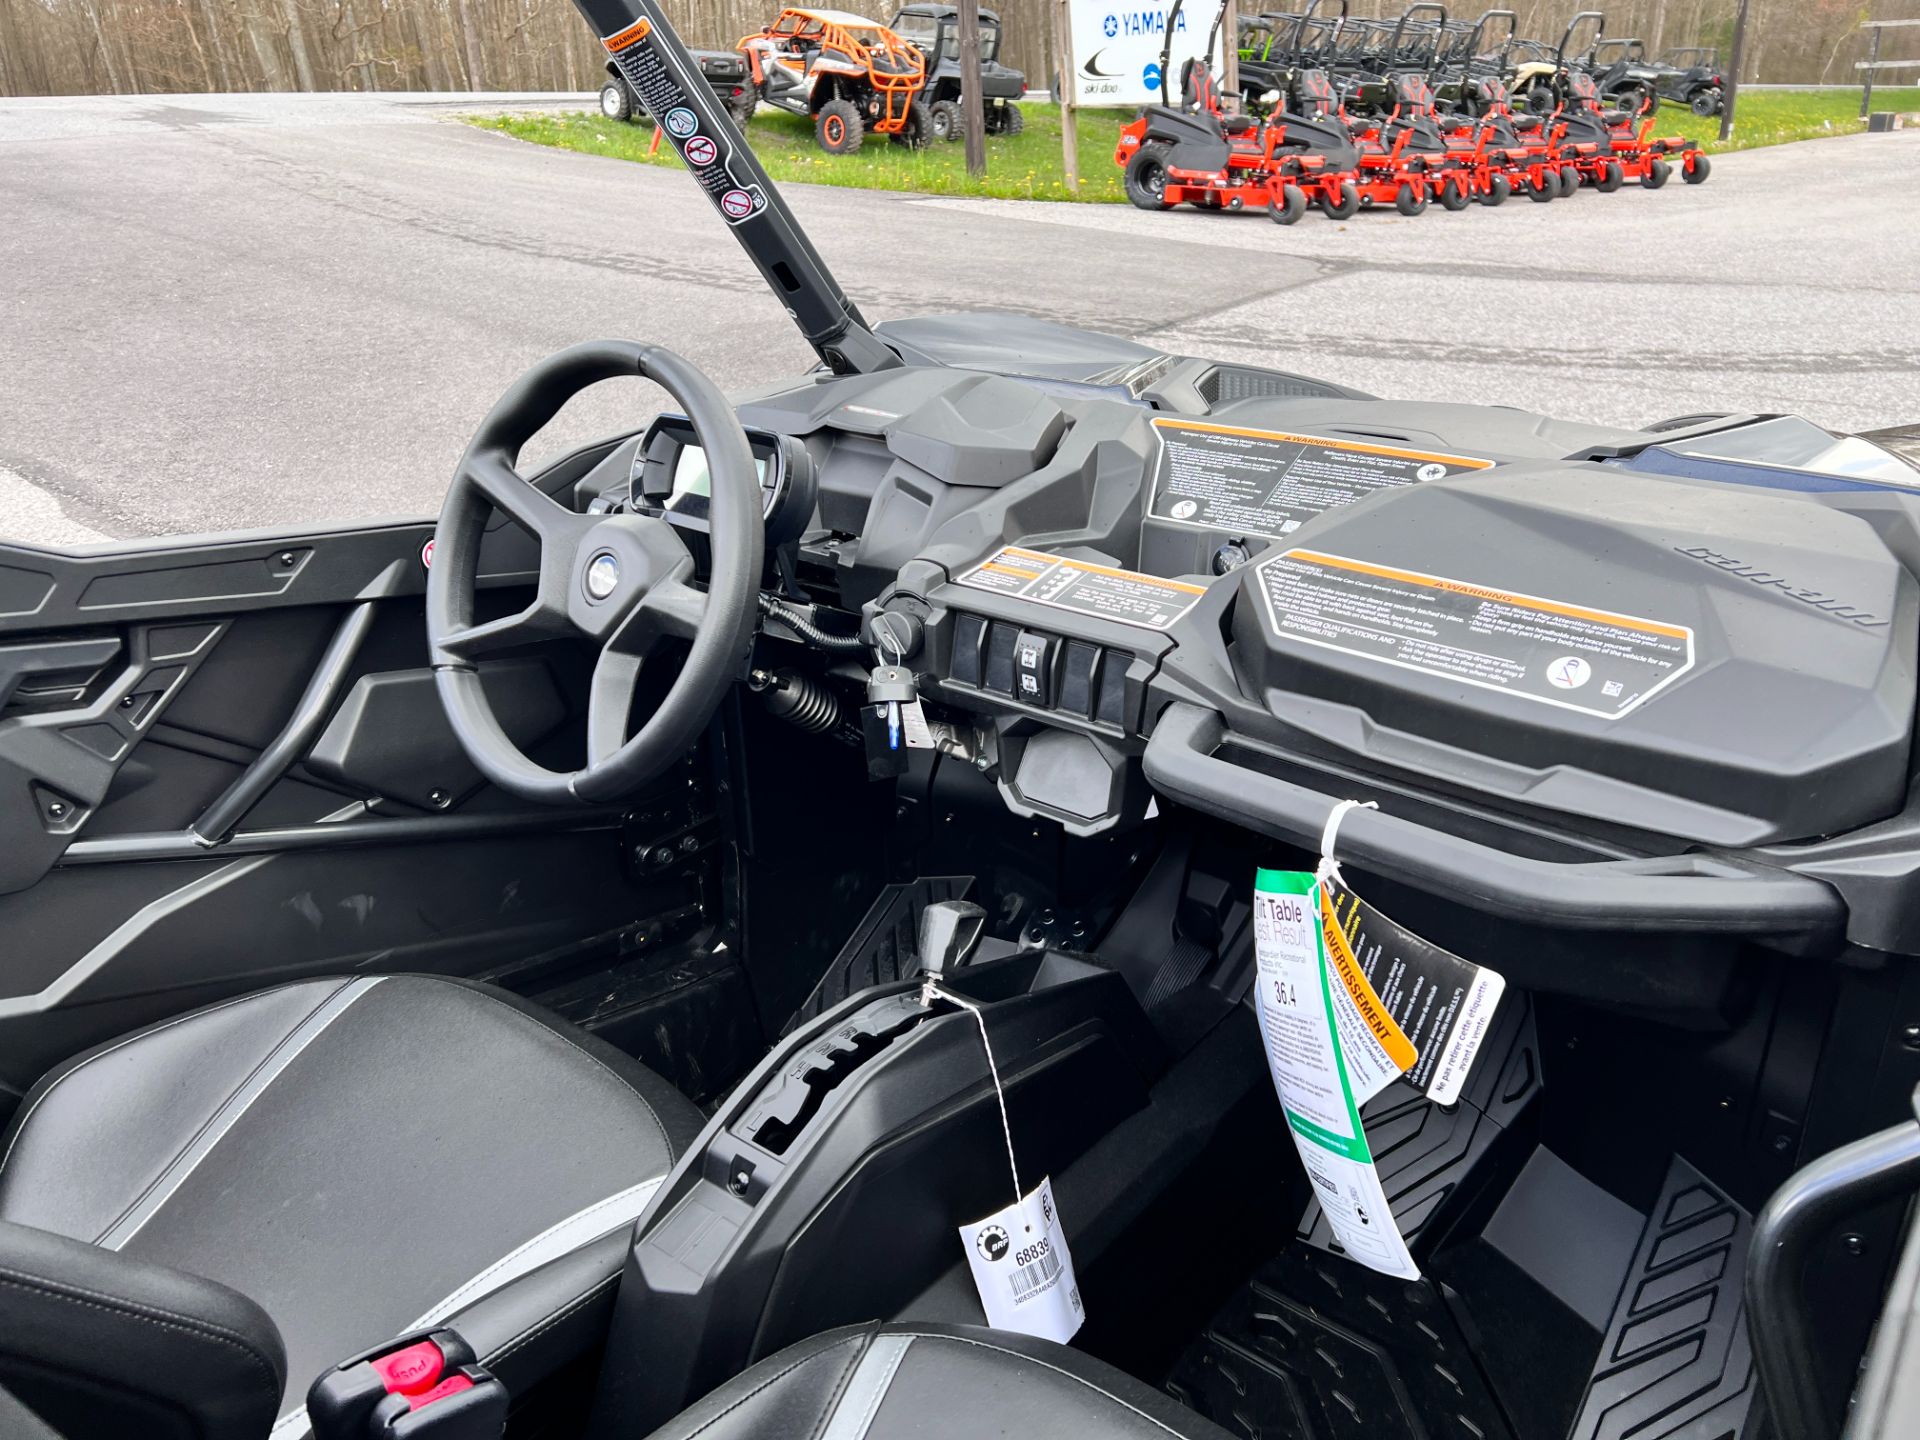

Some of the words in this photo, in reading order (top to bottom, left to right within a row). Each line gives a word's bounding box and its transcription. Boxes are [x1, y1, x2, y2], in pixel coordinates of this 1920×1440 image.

[613, 26, 645, 48] WARNING
[1292, 436, 1337, 446] WARNING
[1446, 582, 1512, 602] WARNING
[1284, 612, 1322, 628] PASSENGER
[1322, 621, 1377, 641] QUALIFICATIONS
[1377, 634, 1395, 645] AND
[1268, 899, 1302, 923] Table
[1273, 920, 1306, 946] Result
[1274, 981, 1297, 1007] 36.4
[1325, 931, 1391, 1040] AVERTISSEMENT
[1466, 979, 1490, 1018] étiquette
[1343, 997, 1362, 1022] USAGE
[1384, 1059, 1395, 1070] ET
[1457, 1018, 1472, 1041] cette
[1470, 1013, 1488, 1039] vente.
[1445, 1040, 1463, 1066] retirer
[1466, 1039, 1476, 1048] la
[1457, 1048, 1472, 1071] avant
[1441, 1066, 1453, 1081] pas
[1435, 1080, 1446, 1092] Ne
[991, 1237, 1009, 1253] BRP
[1016, 1236, 1049, 1267] 68839
